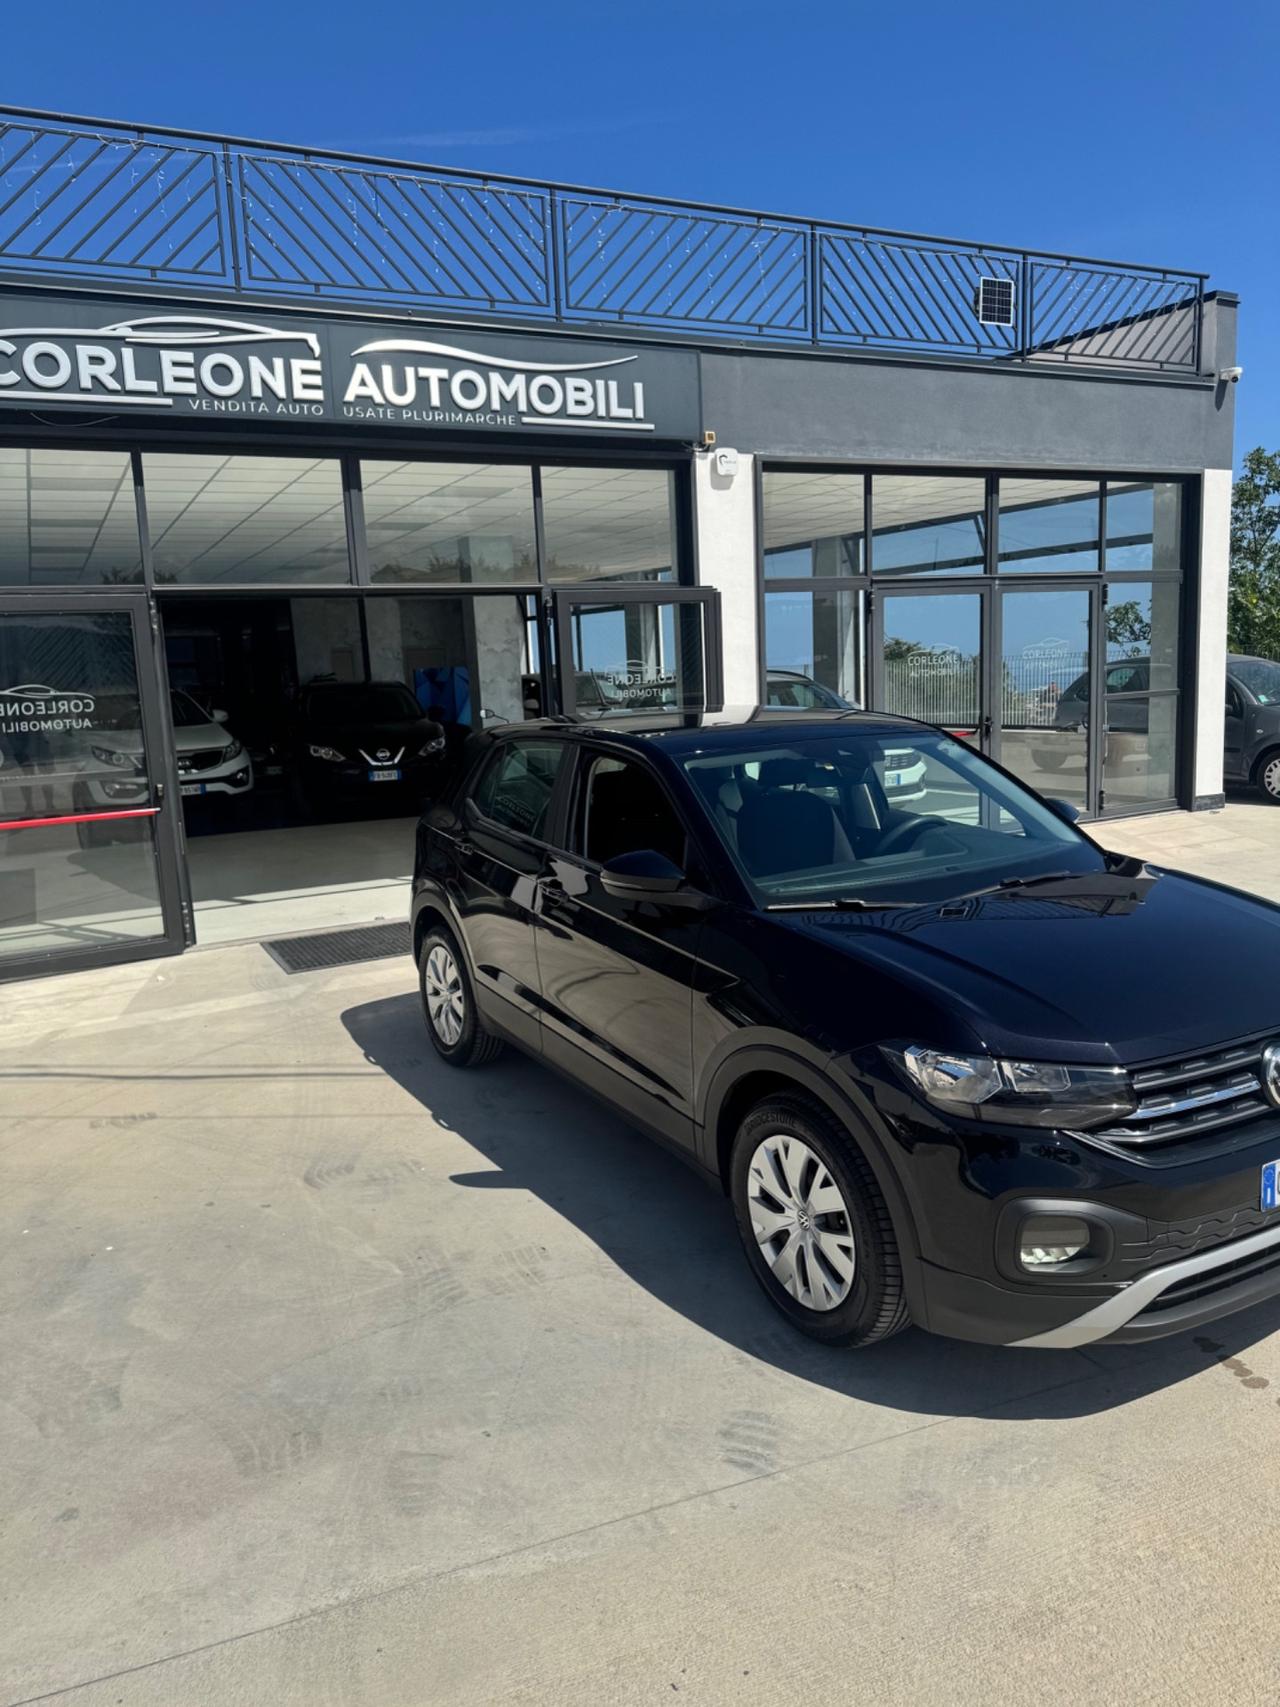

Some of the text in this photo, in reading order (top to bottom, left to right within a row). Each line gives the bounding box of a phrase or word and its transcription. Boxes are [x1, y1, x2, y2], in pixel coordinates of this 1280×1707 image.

[343, 363, 645, 419] AUTOMOBILI
[189, 399, 516, 426] VENDITA AUTO USATE PLURIMARCHE
